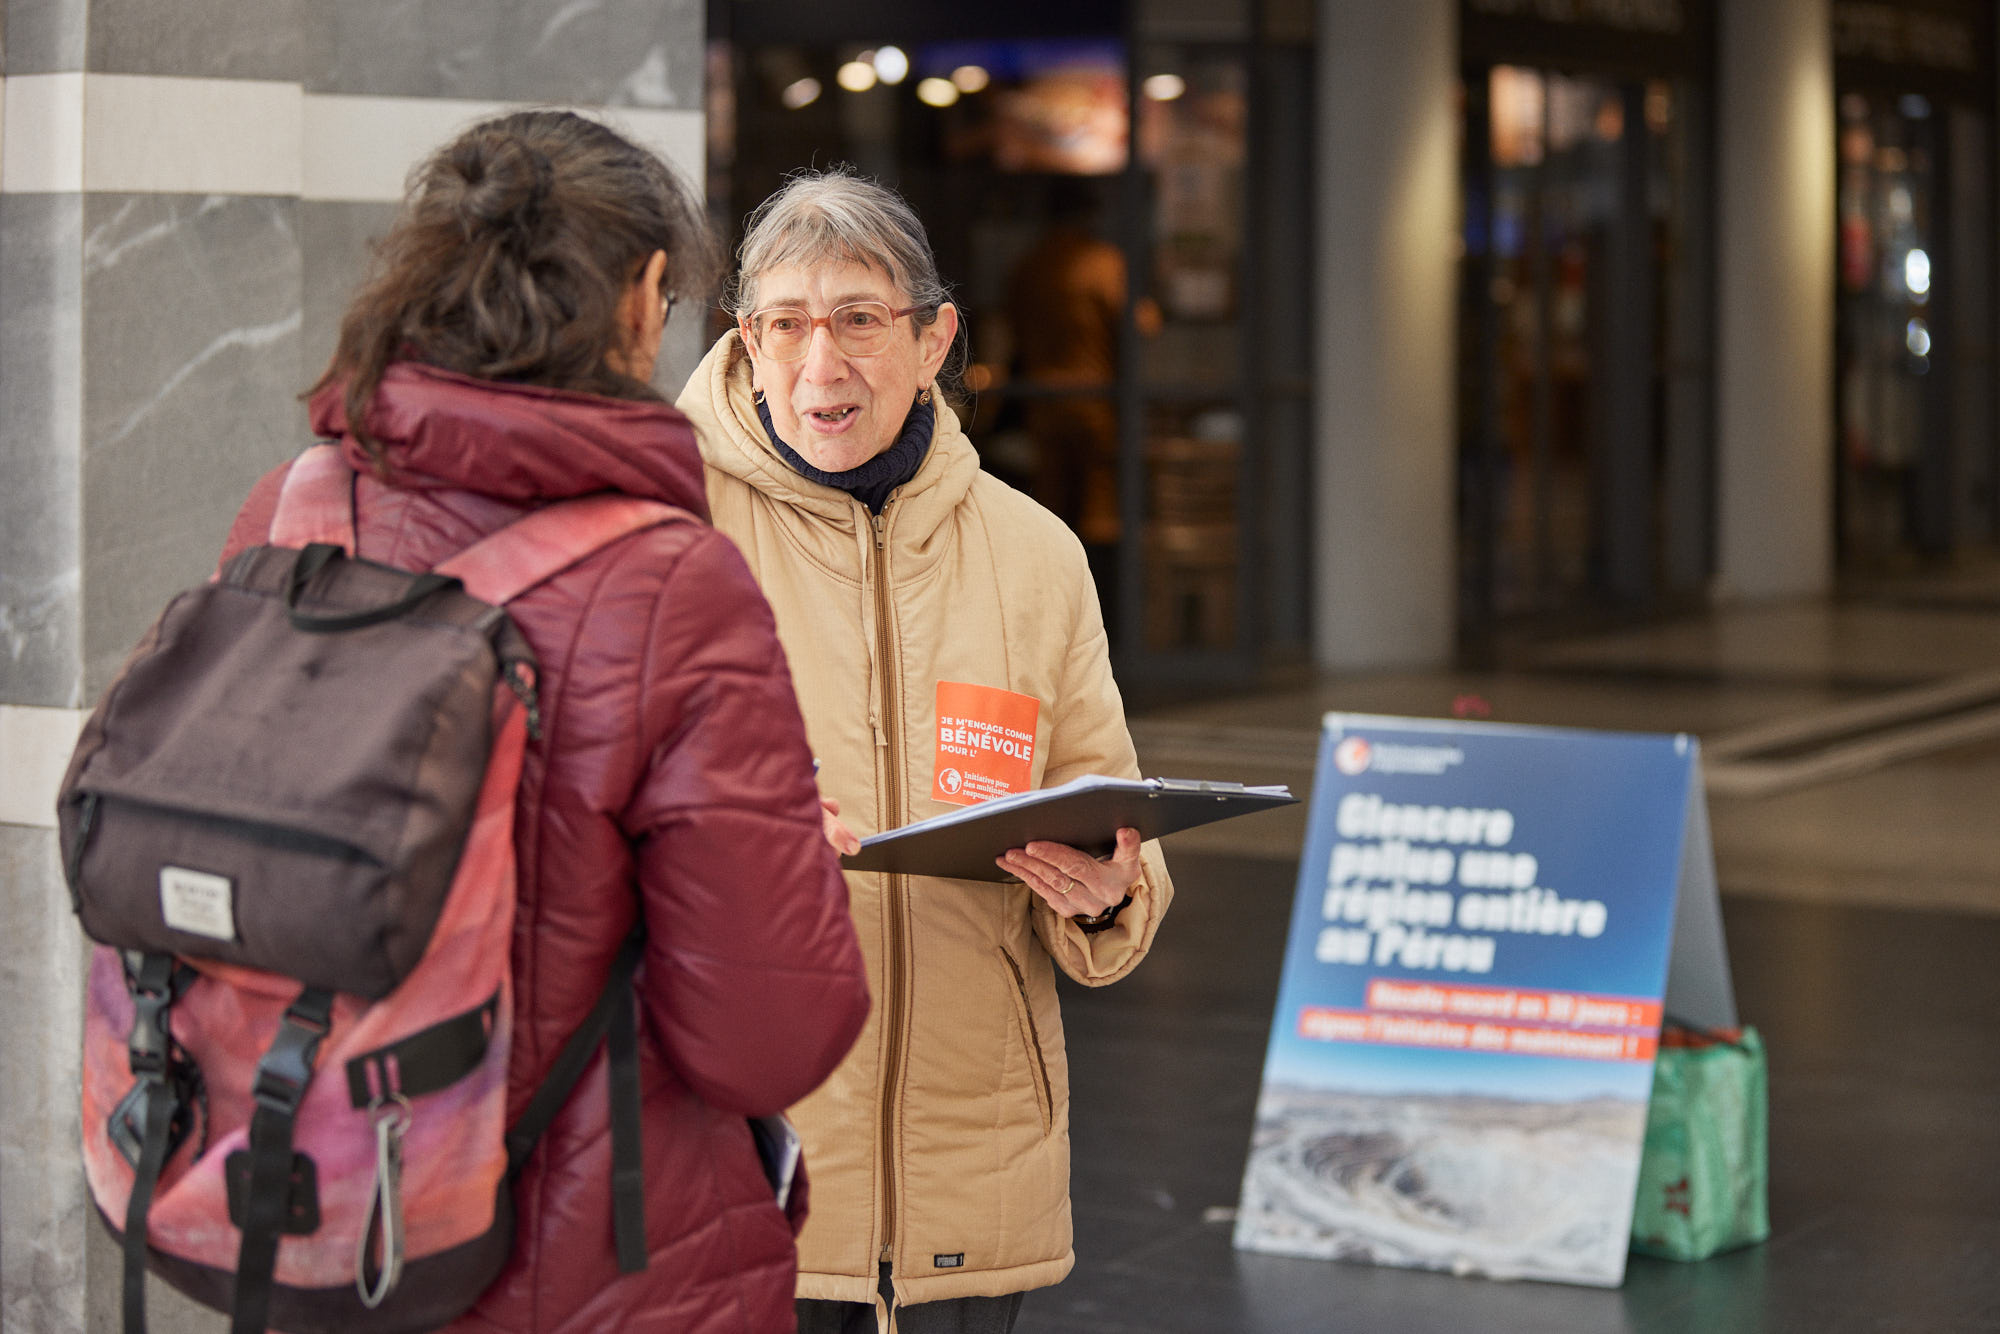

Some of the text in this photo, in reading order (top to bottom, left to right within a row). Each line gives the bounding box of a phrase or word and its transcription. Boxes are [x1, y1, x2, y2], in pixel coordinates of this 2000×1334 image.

[940, 726, 1032, 761] BÉNÉVOLE
[941, 717, 1033, 742] JE M'ENGAGE COMME
[941, 744, 977, 758] POUR L'
[963, 780, 976, 789] des
[964, 771, 1010, 789] Initiative pour
[1337, 792, 1514, 846] Glencore
[1328, 840, 1538, 888] pollue une
[1323, 880, 1607, 939] région entière
[1315, 924, 1497, 973] au Pérou
